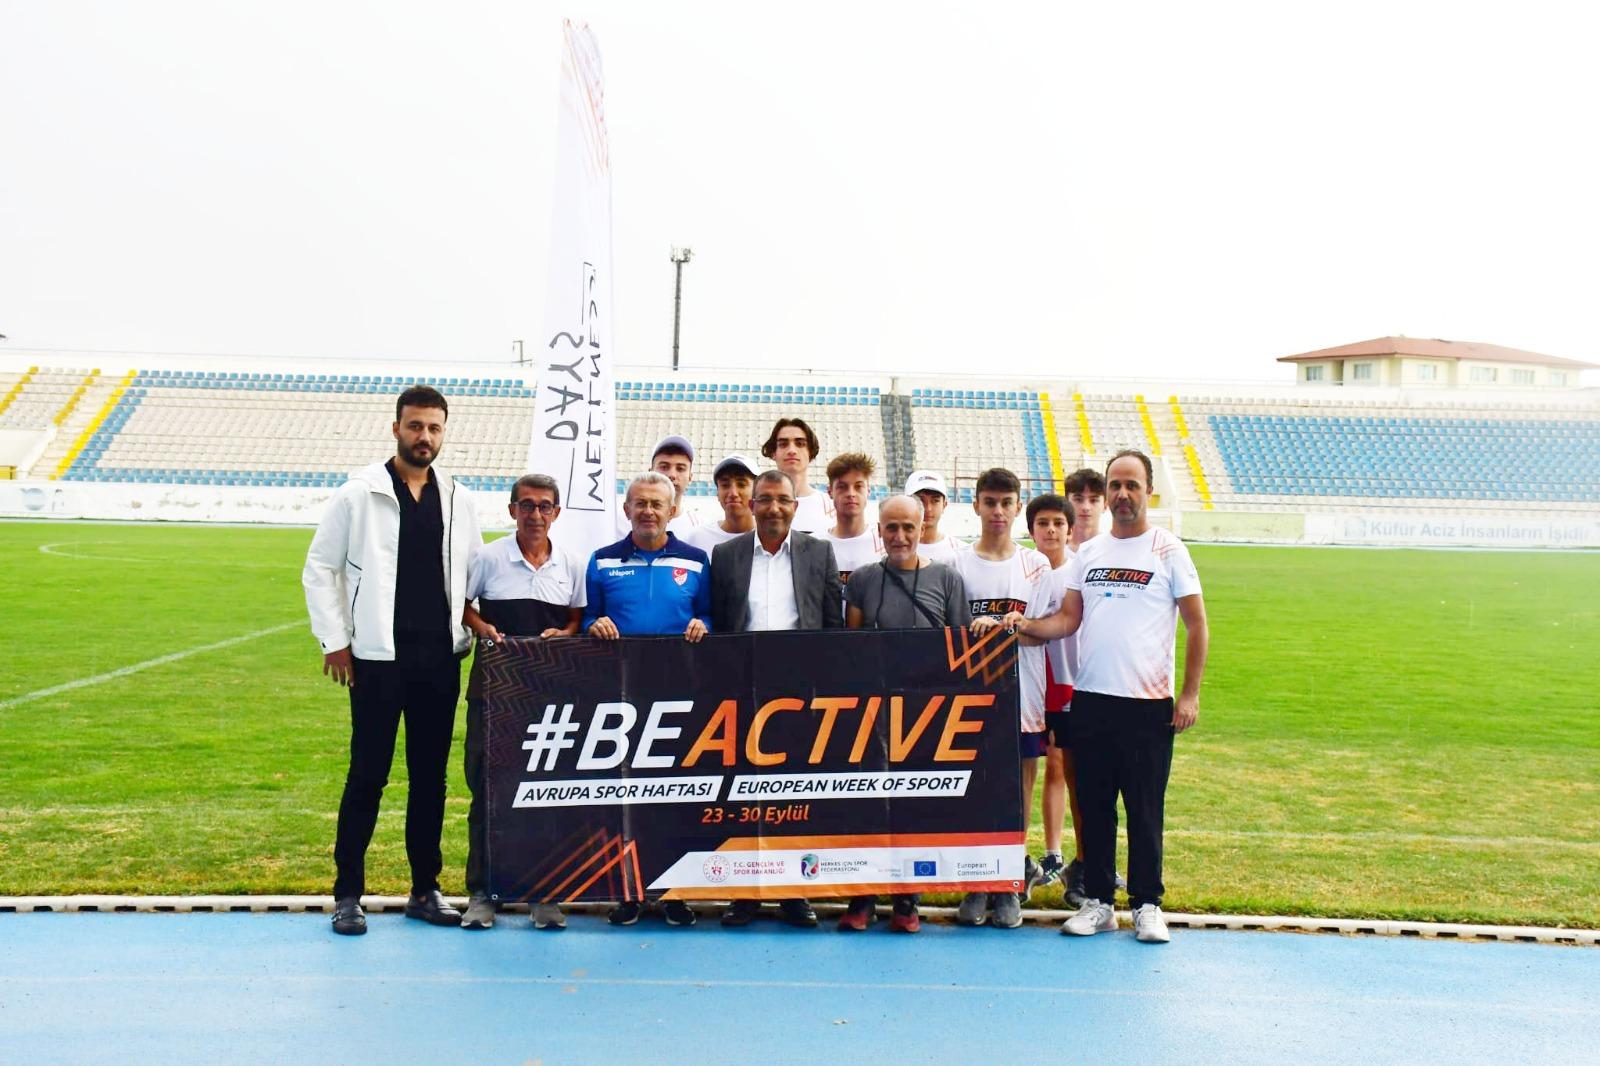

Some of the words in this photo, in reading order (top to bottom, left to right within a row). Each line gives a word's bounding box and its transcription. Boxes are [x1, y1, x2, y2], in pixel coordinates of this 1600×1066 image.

[1370, 522, 1416, 537] Küfür
[1420, 522, 1455, 538] Aciz
[608, 569, 635, 577] uhlsport
[1087, 569, 1151, 583] #BEACTIVE
[521, 694, 996, 772] #BEACTIVE
[522, 785, 590, 801] AVRUPA
[594, 784, 639, 799] SPOR
[641, 782, 714, 798] HAFTASI
[736, 779, 828, 794] EUROPEAN
[832, 778, 877, 792] WEEK
[882, 777, 905, 791] OF
[906, 777, 964, 791] SPORT
[702, 807, 724, 824] 23
[739, 807, 761, 823] 30
[765, 804, 810, 825] Eylül
